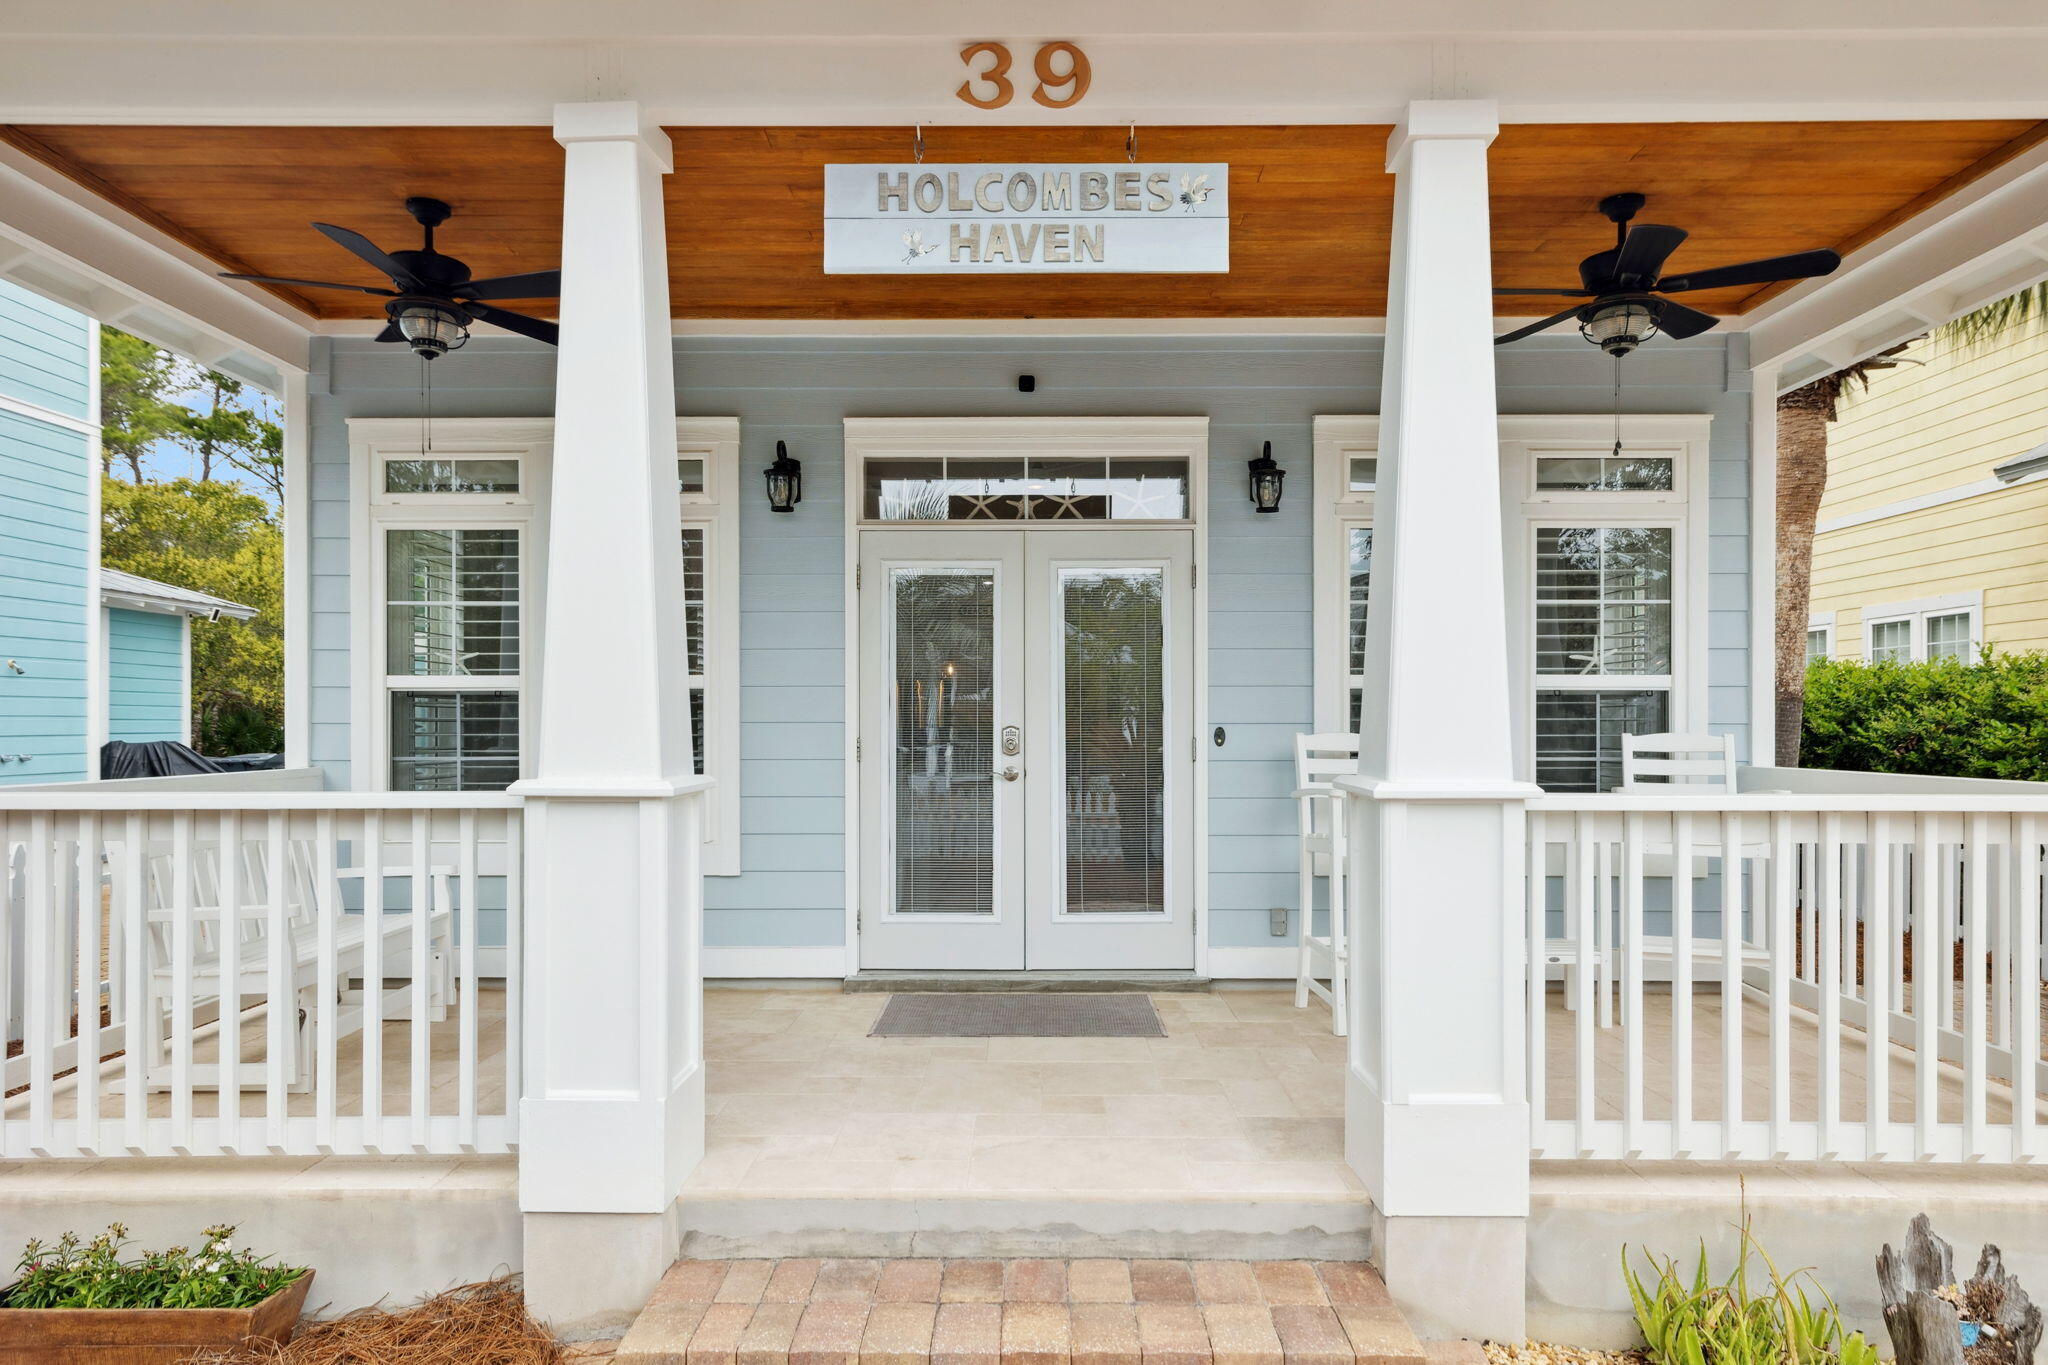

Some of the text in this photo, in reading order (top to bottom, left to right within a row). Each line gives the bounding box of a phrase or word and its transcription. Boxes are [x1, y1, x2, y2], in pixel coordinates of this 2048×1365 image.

[956, 42, 1091, 109] 39
[878, 171, 1174, 213] HOLCOMBES
[949, 223, 1105, 263] HAVEN
